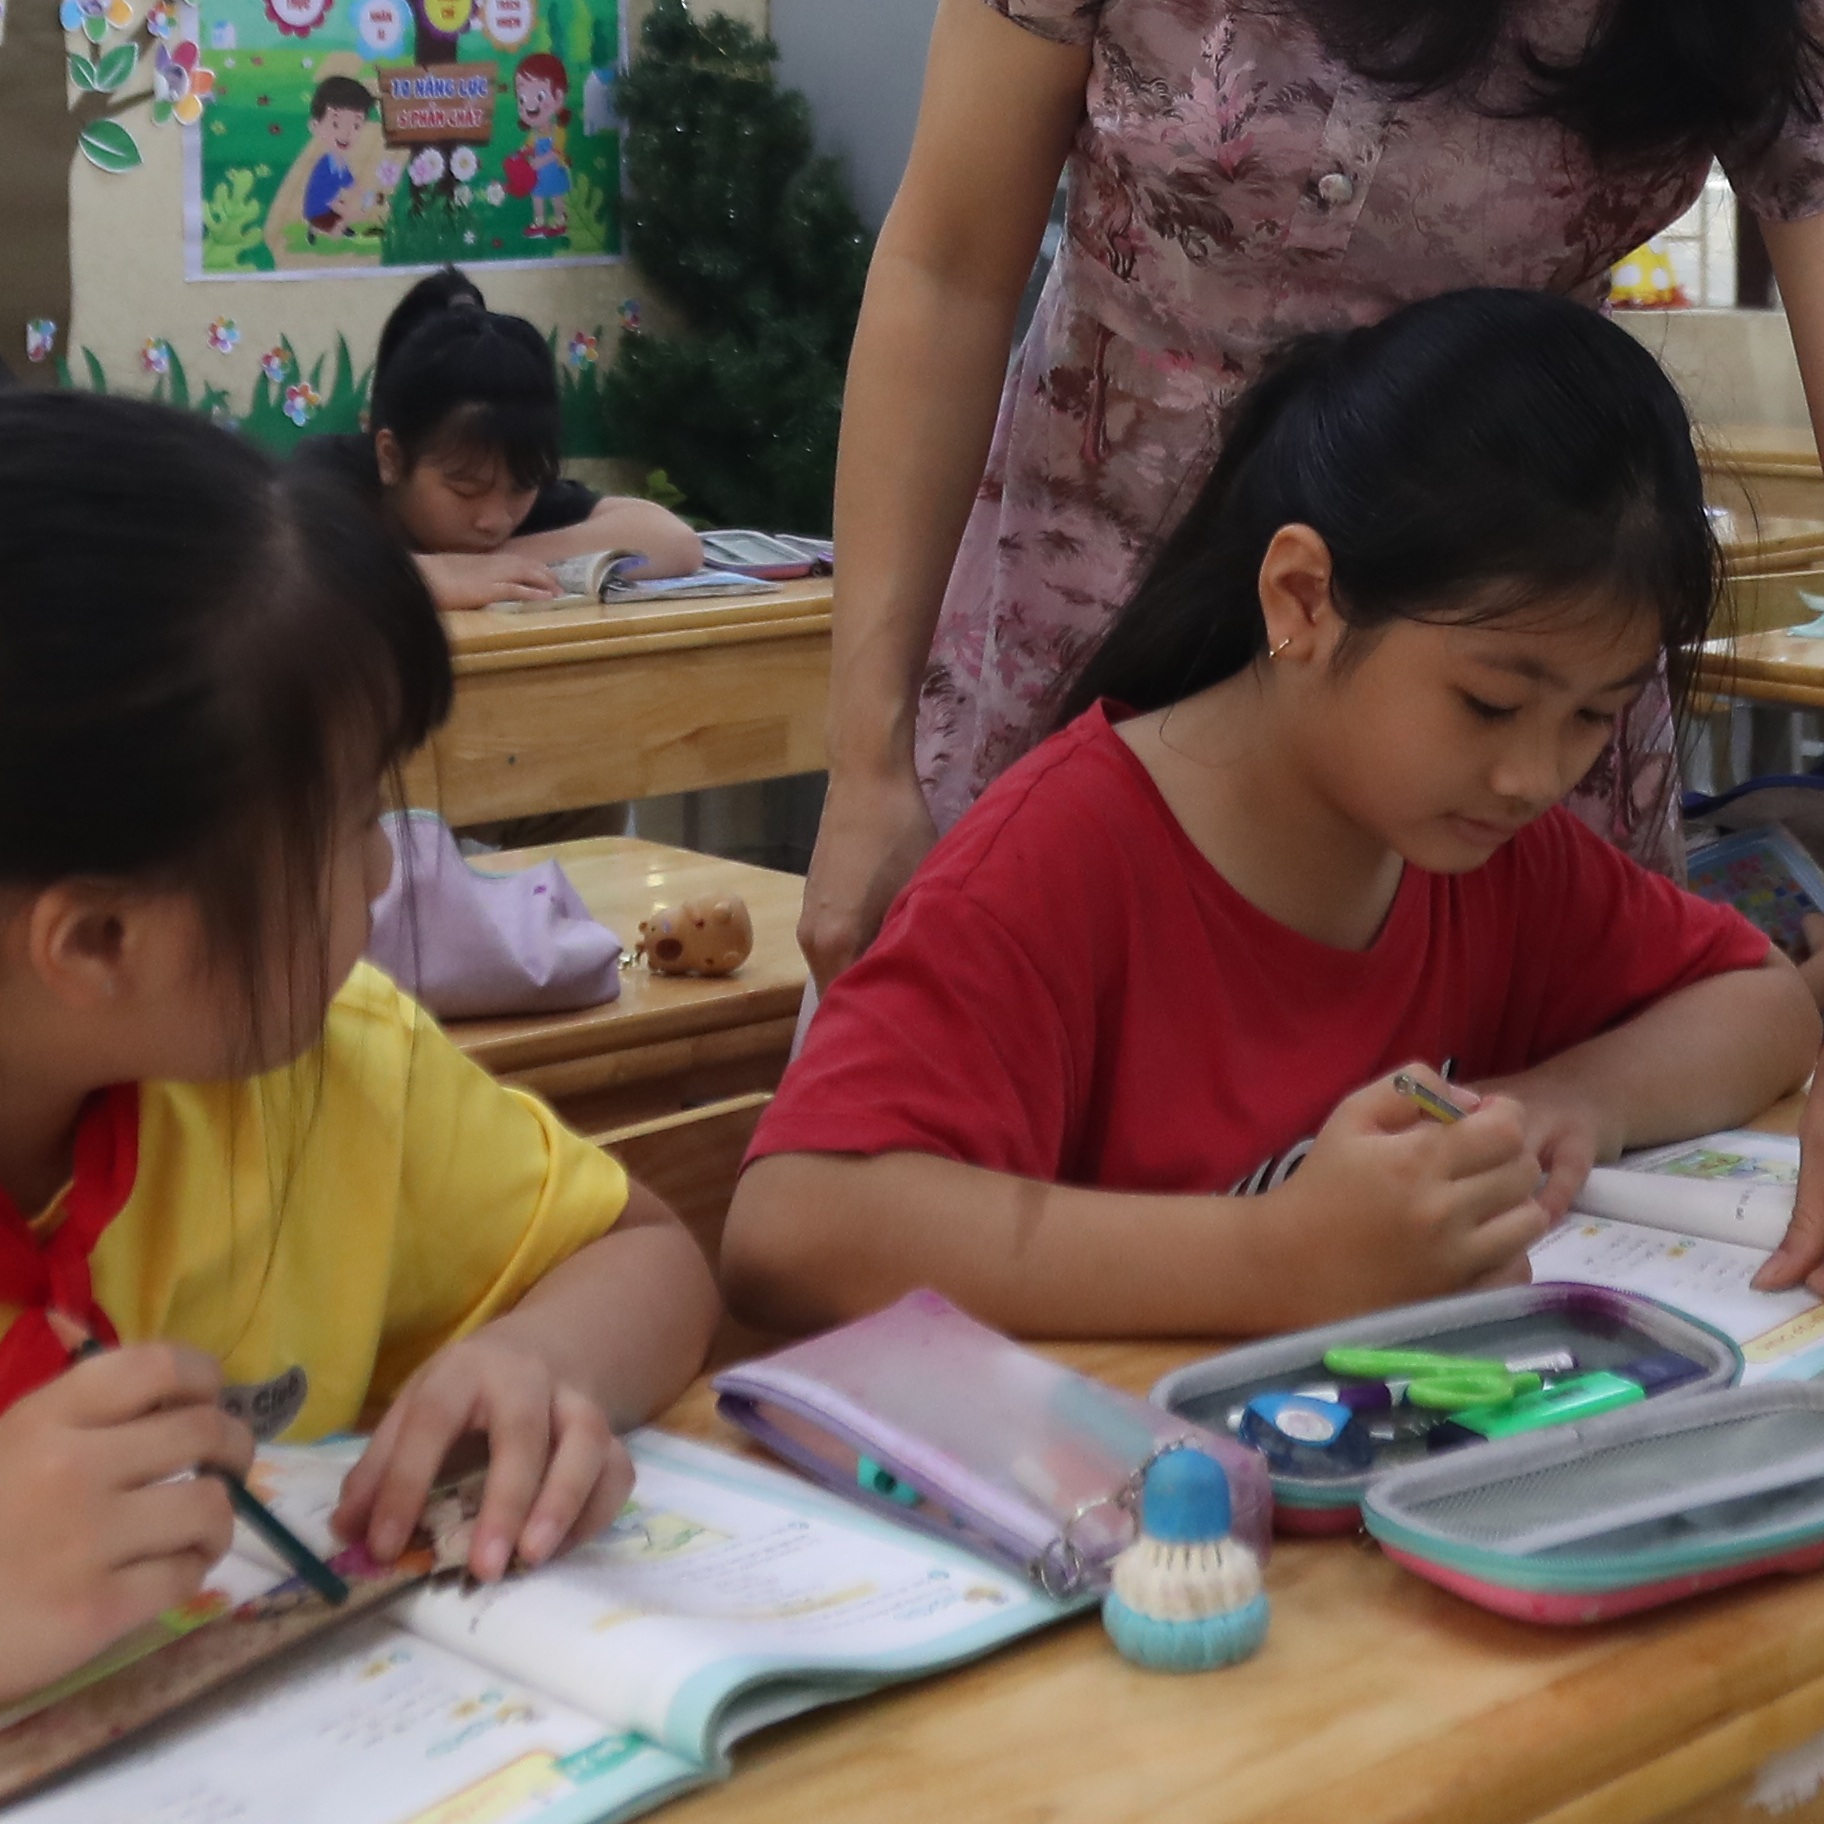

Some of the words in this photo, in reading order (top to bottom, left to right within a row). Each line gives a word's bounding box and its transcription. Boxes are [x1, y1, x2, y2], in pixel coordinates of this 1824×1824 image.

[391, 78, 411, 99] 10
[414, 73, 455, 99] NĂNG
[458, 75, 488, 99] LỰC
